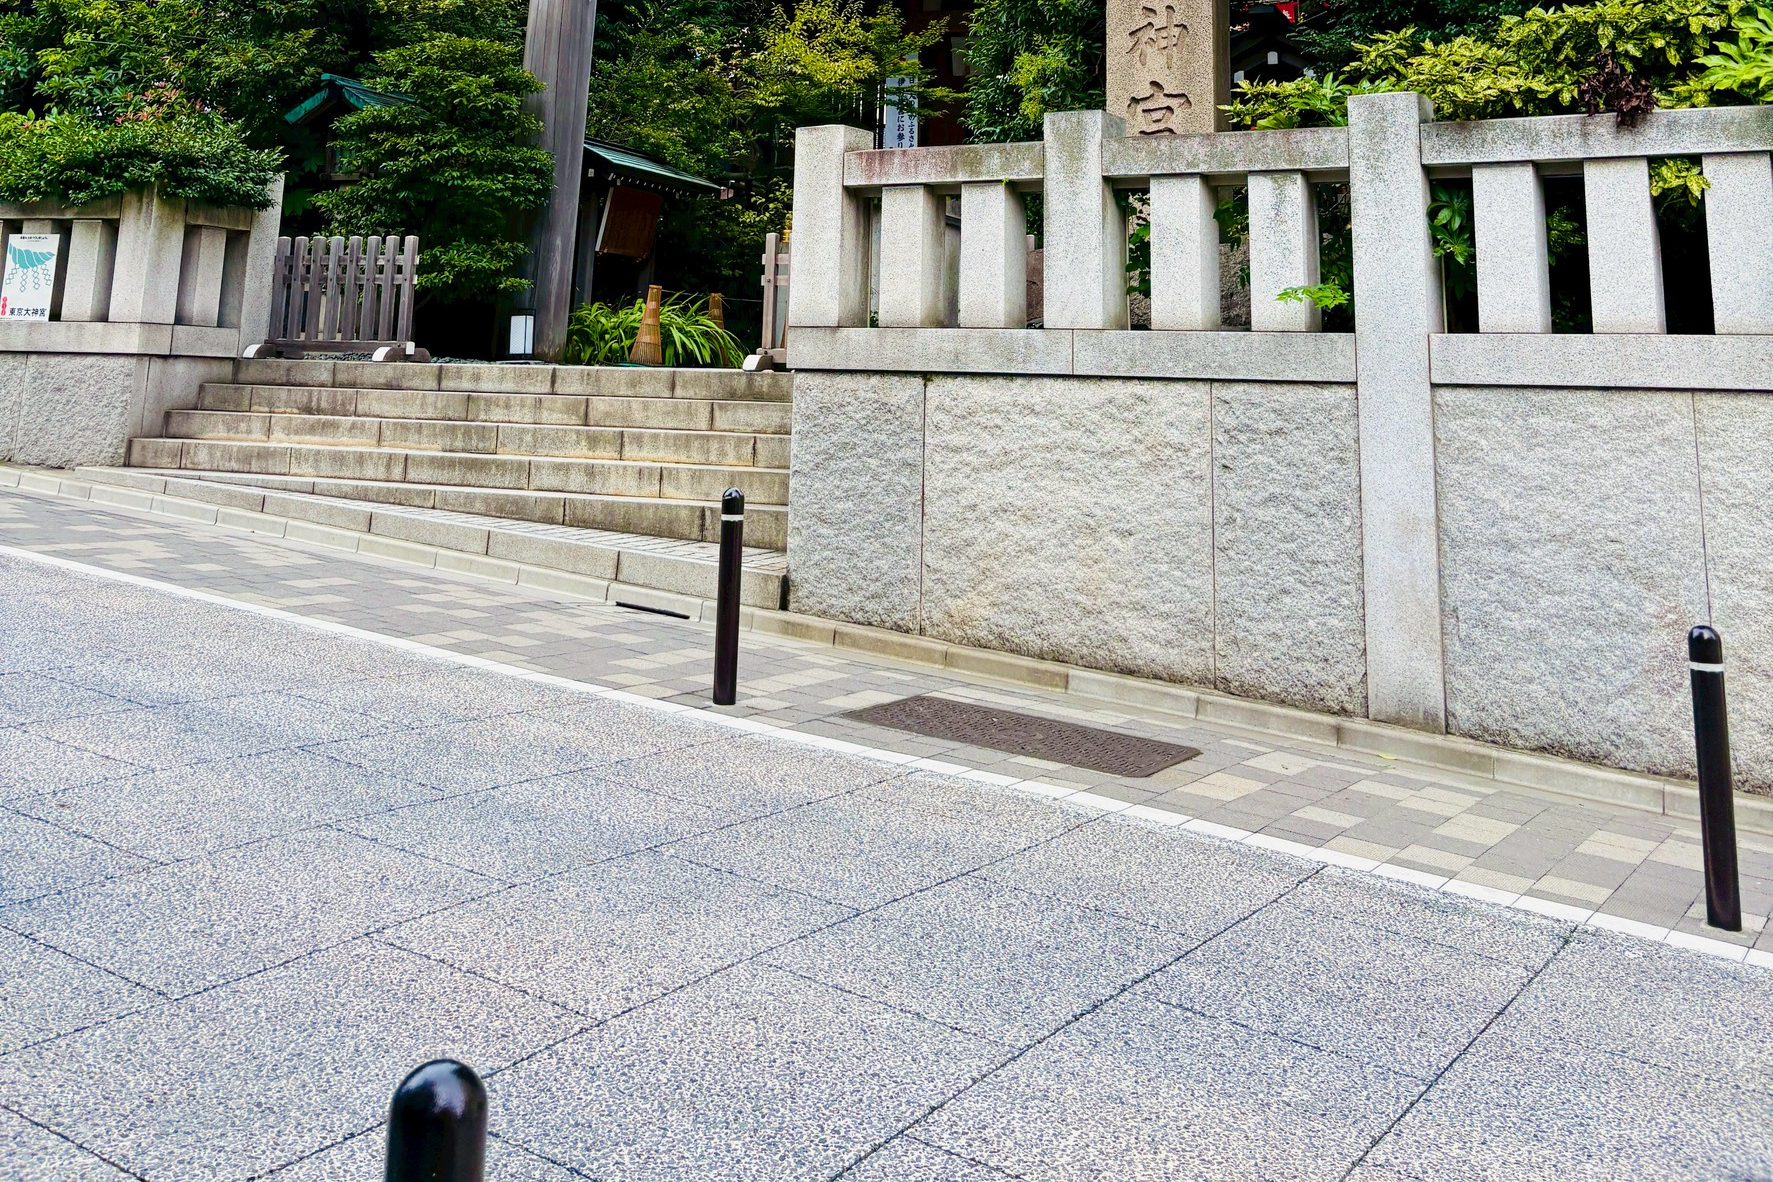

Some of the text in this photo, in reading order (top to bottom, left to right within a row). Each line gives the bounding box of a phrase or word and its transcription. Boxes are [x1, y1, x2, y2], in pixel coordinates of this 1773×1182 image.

[9, 307, 47, 317] 東京大神宮
